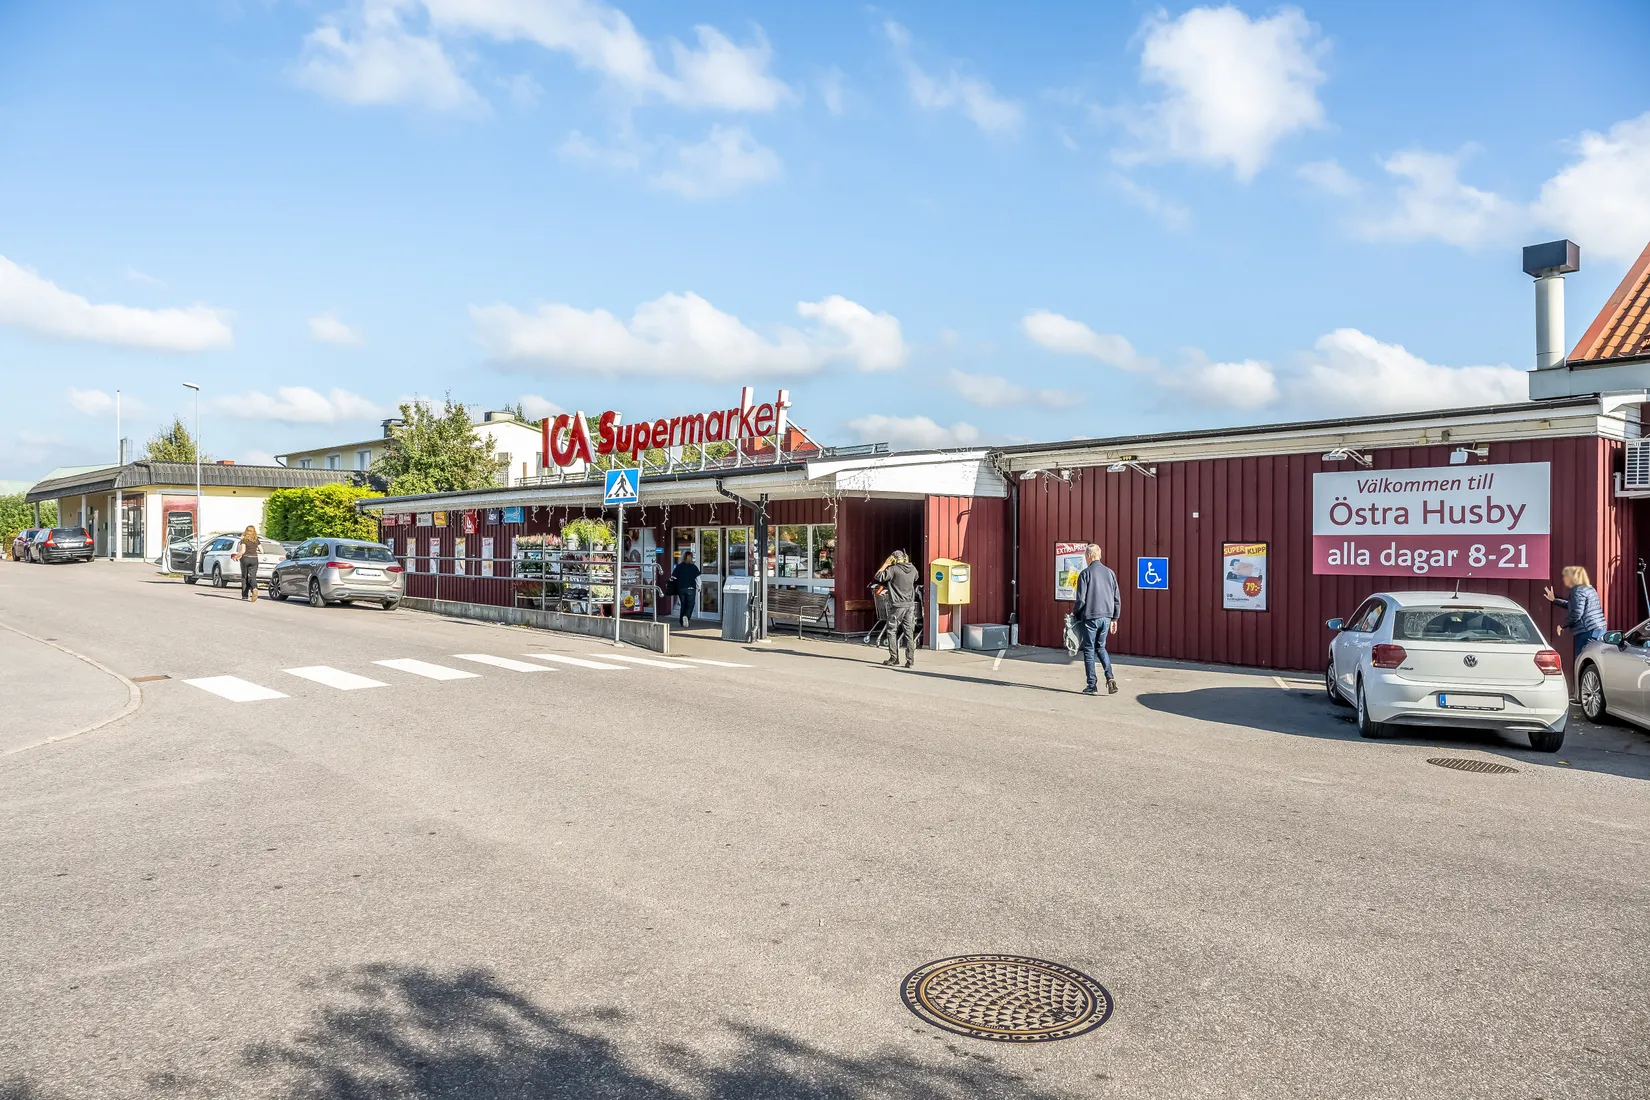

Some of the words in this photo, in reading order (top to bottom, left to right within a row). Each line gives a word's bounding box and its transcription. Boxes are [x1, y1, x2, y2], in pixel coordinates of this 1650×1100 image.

[541, 411, 596, 468] ICA
[597, 386, 790, 461] Supermarket
[1357, 477, 1461, 494] Välkommen
[1467, 473, 1494, 490] till
[1329, 496, 1409, 526] Östra
[1422, 496, 1526, 531] Husby
[1247, 547, 1266, 555] KLIPP
[1327, 542, 1370, 566] alla
[1380, 542, 1458, 574] dagar
[1468, 544, 1529, 568] 8-21
